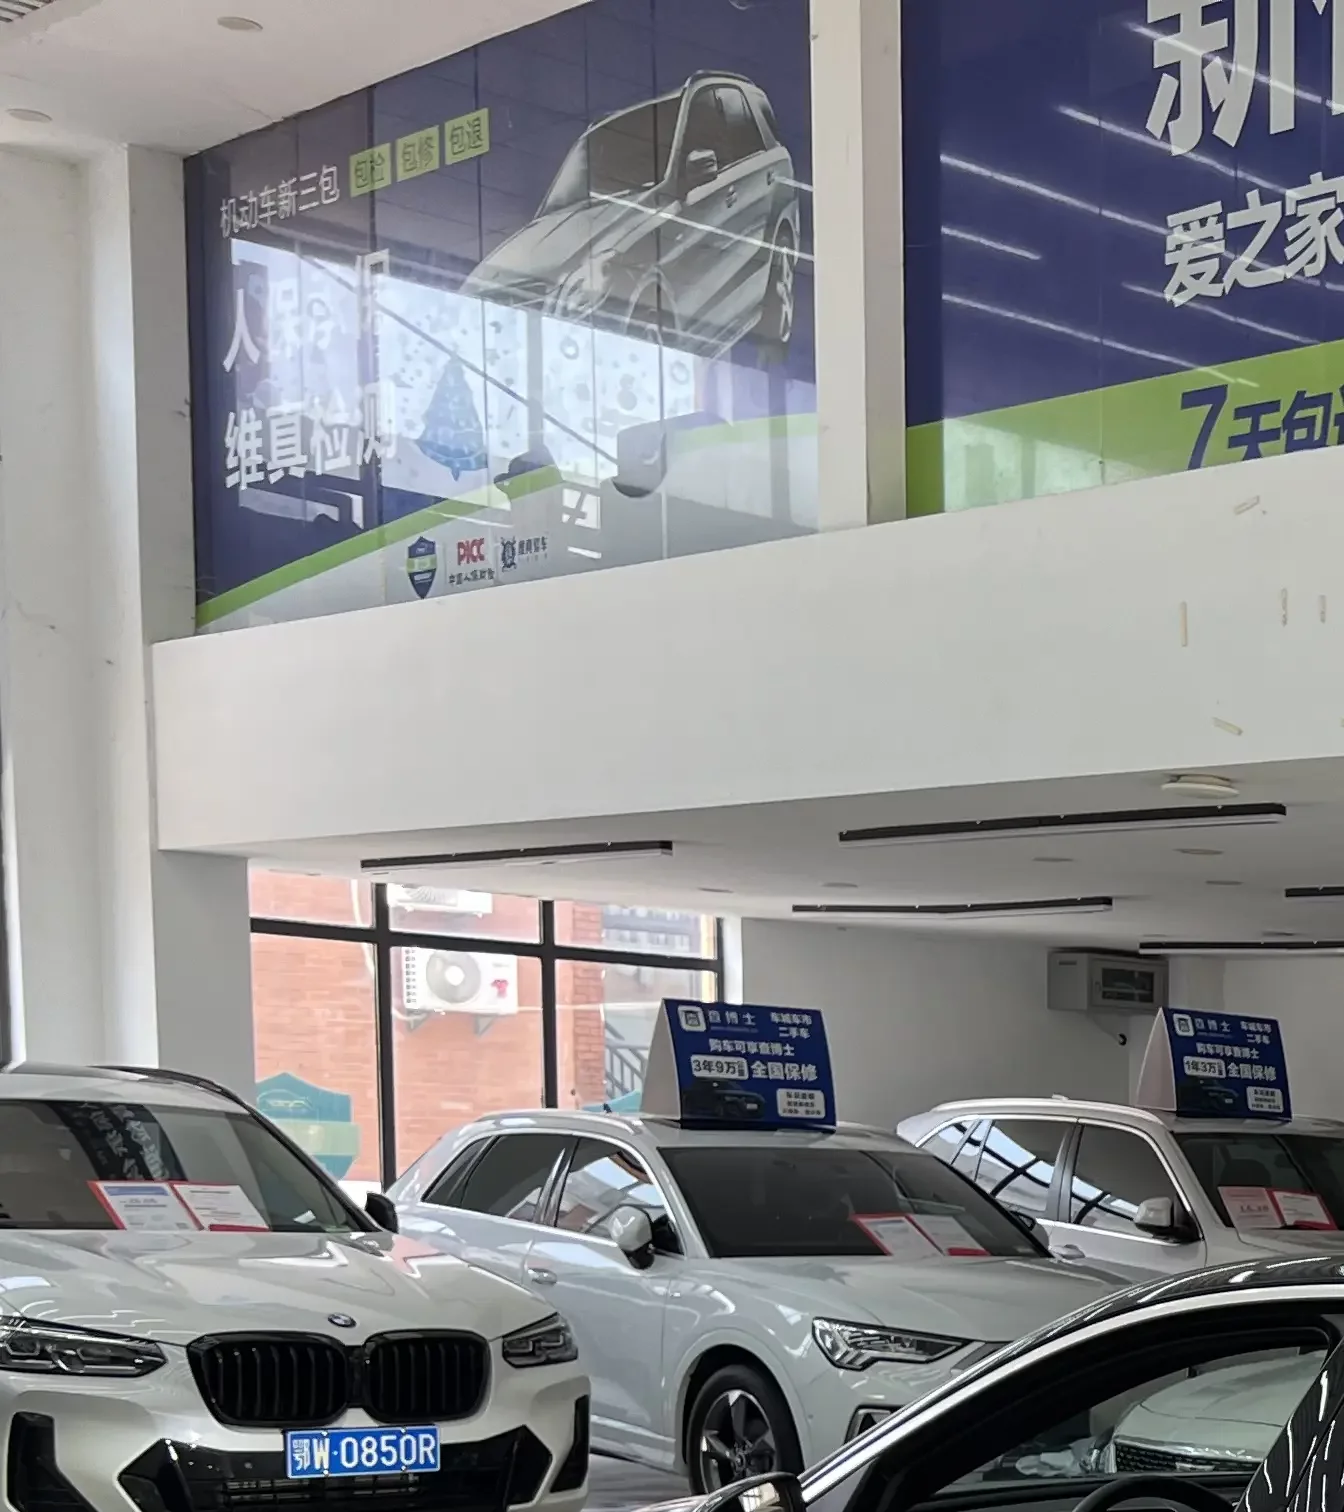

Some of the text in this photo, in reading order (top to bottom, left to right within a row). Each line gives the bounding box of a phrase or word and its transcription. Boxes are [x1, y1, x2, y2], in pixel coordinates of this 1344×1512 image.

[220, 164, 340, 239] 机动车新三包
[401, 133, 435, 173] 包修
[449, 116, 484, 156] 包退
[751, 1060, 818, 1081] 全国保修
